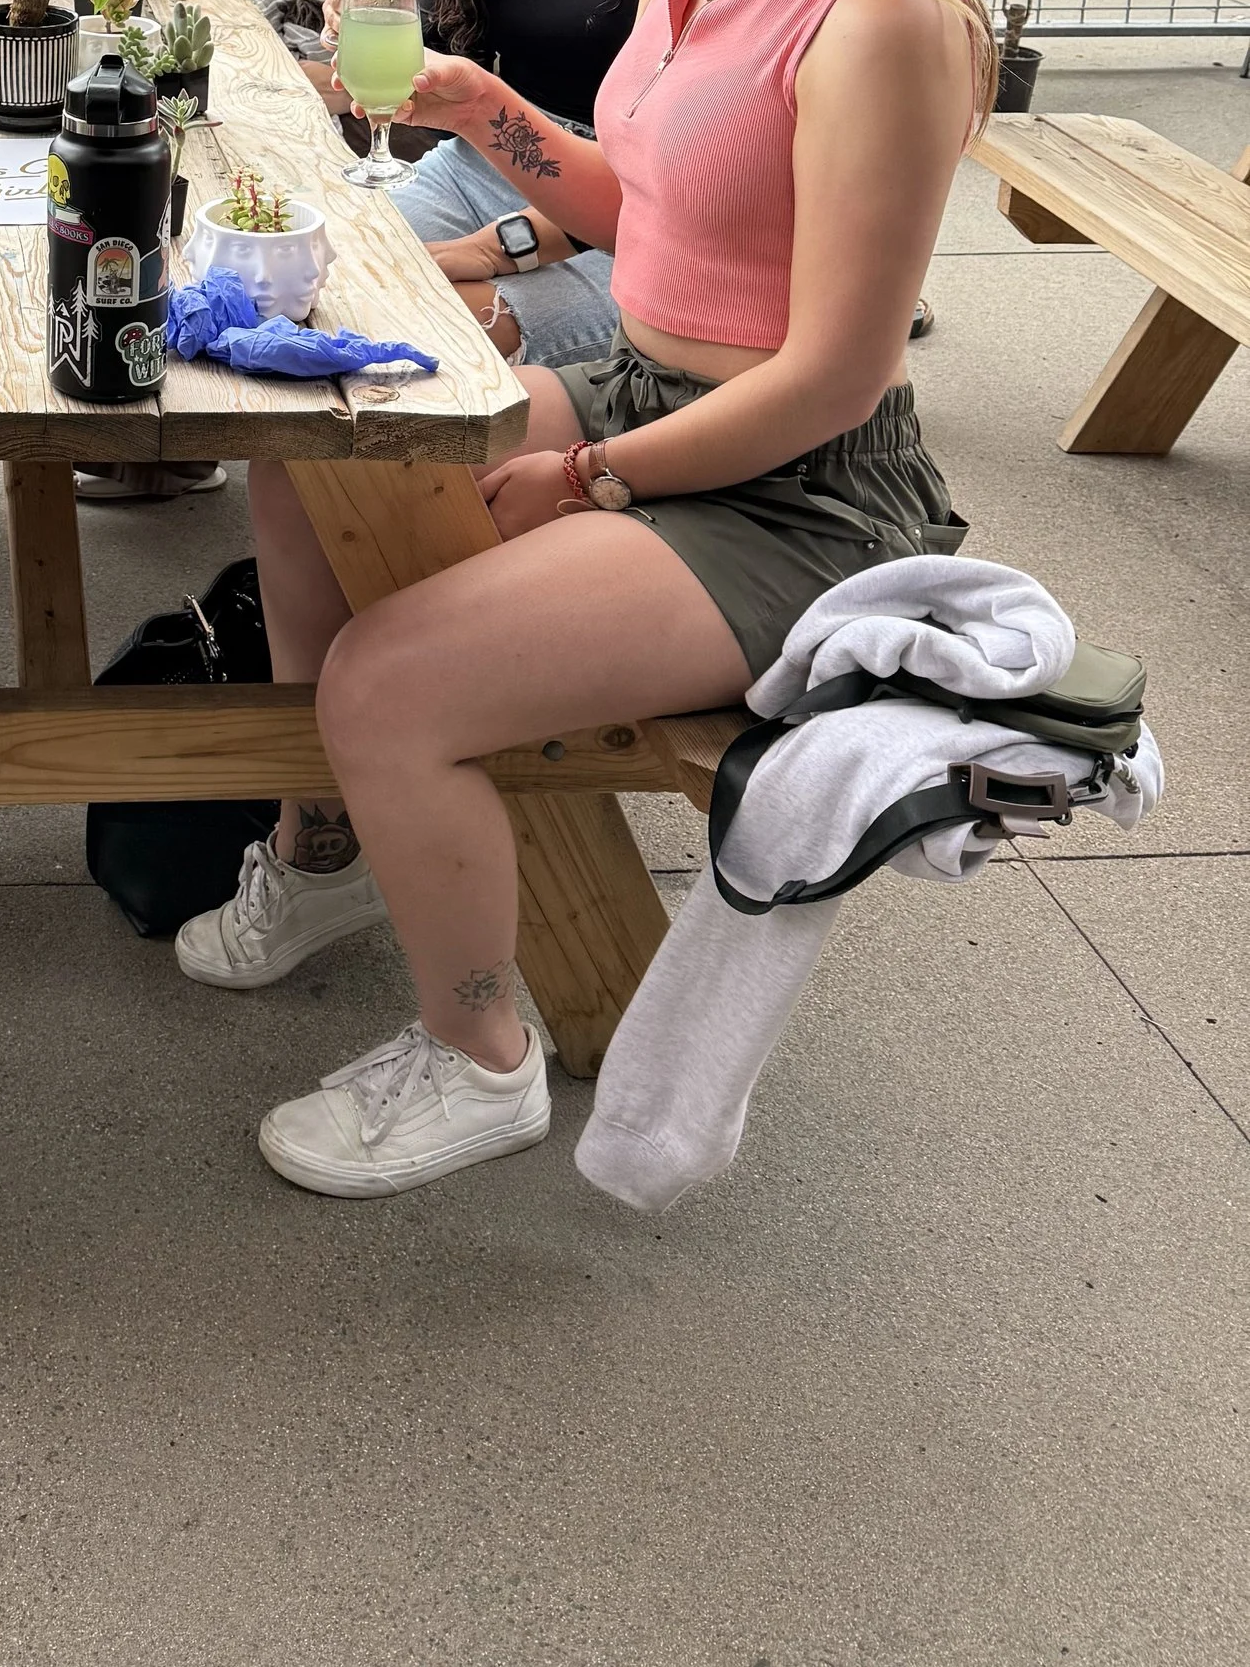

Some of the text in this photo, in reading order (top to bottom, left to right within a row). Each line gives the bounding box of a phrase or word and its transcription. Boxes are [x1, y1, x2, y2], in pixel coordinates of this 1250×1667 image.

[60, 225, 90, 242] BOOKS
[95, 239, 134, 252] SAN DIEGO
[95, 297, 118, 305] SURF
[129, 331, 166, 357] FORE
